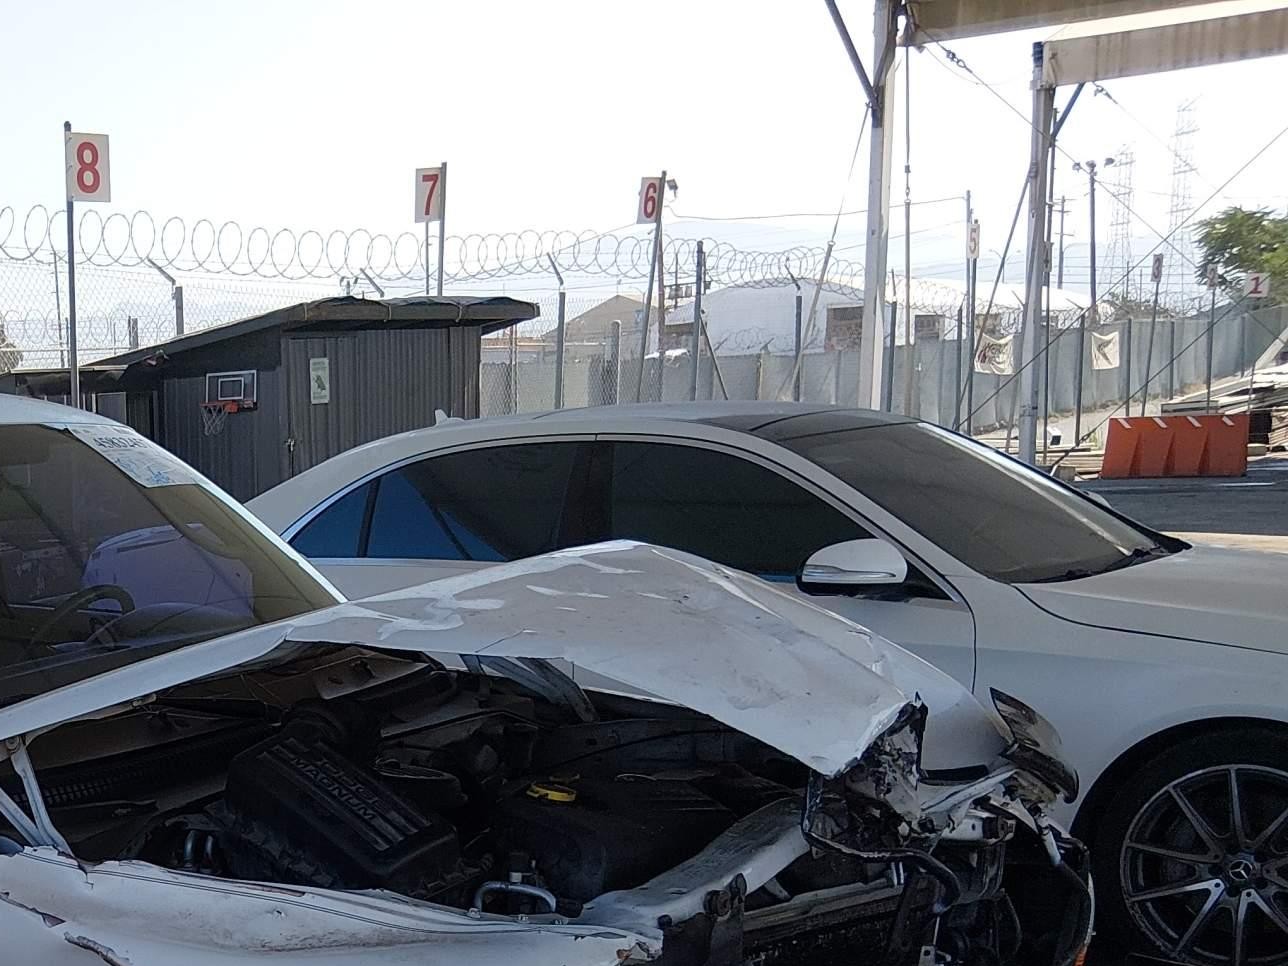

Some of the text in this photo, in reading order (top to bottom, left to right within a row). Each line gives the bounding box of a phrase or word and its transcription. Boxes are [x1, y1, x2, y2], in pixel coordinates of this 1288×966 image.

[76, 141, 101, 194] 8
[422, 173, 439, 216] 7
[643, 182, 657, 219] 6
[969, 228, 978, 255] 5
[1152, 257, 1160, 280] 3
[1250, 276, 1262, 295] 1
[293, 757, 376, 819] MAGNUM
